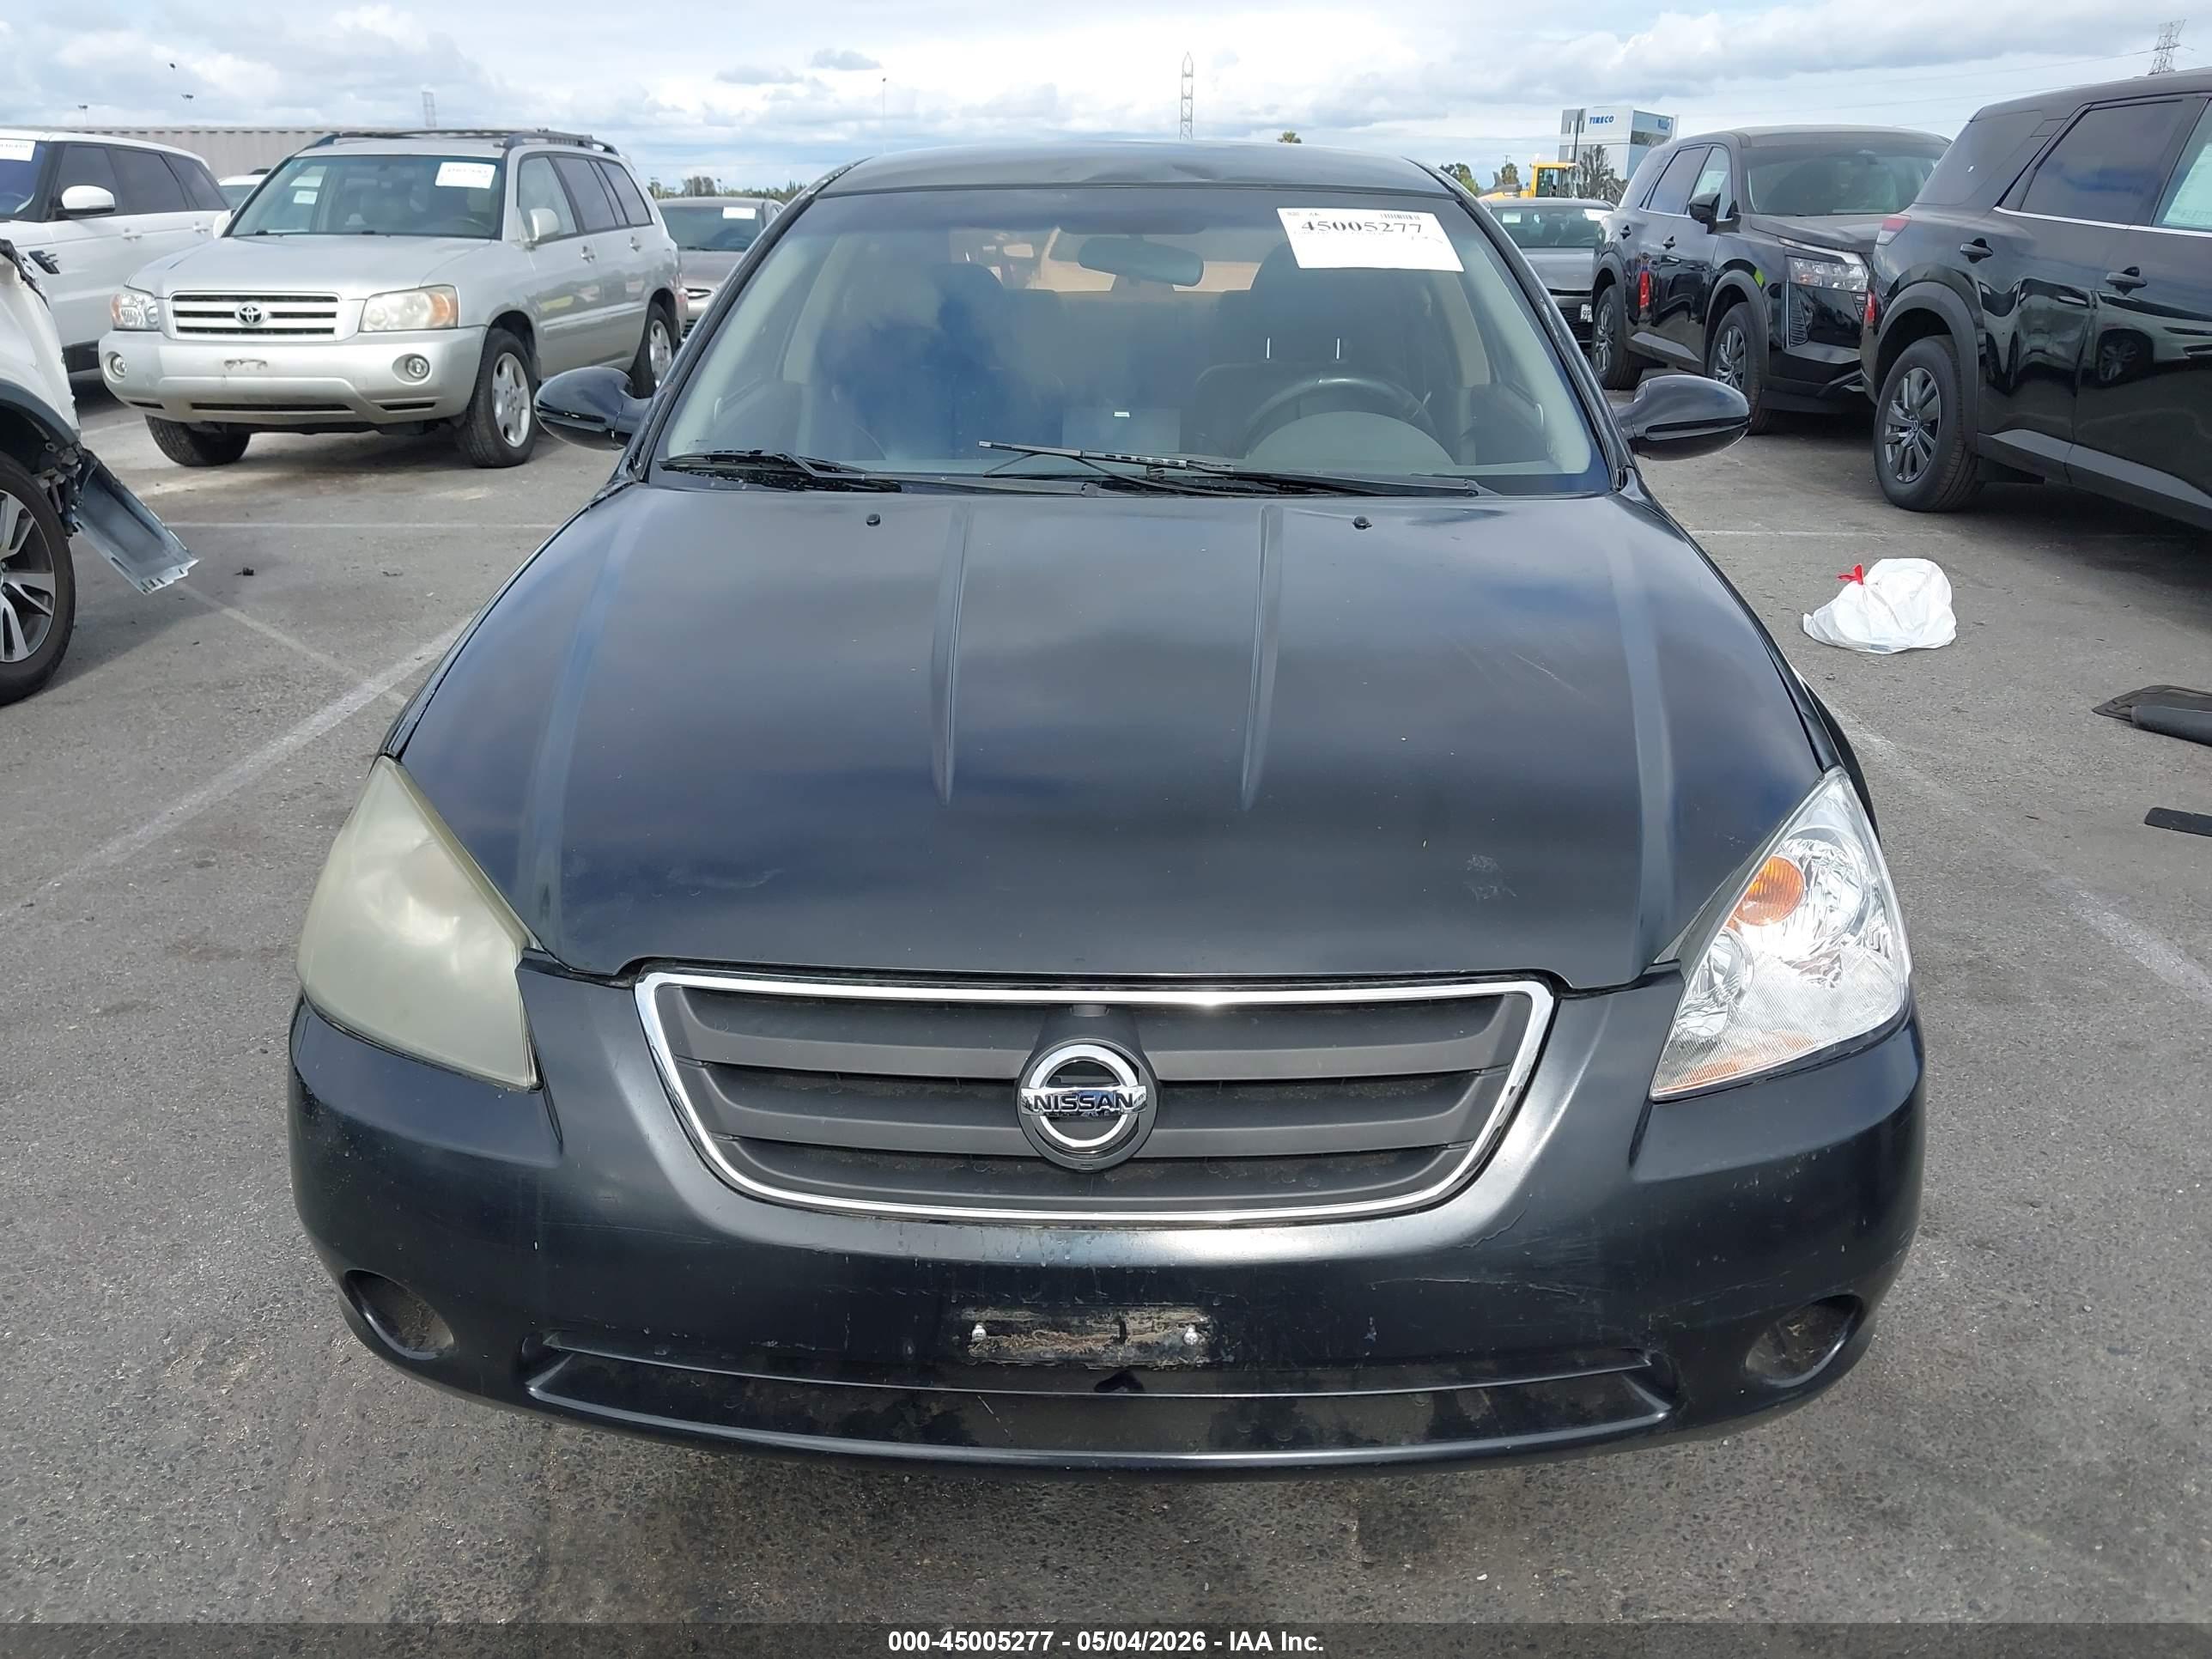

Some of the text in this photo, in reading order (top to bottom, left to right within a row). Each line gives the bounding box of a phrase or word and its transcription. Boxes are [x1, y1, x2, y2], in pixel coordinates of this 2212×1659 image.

[1589, 115, 1614, 125] TIRECO
[1301, 220, 1422, 234] 45005277
[1034, 1092, 1134, 1112] NISSAN
